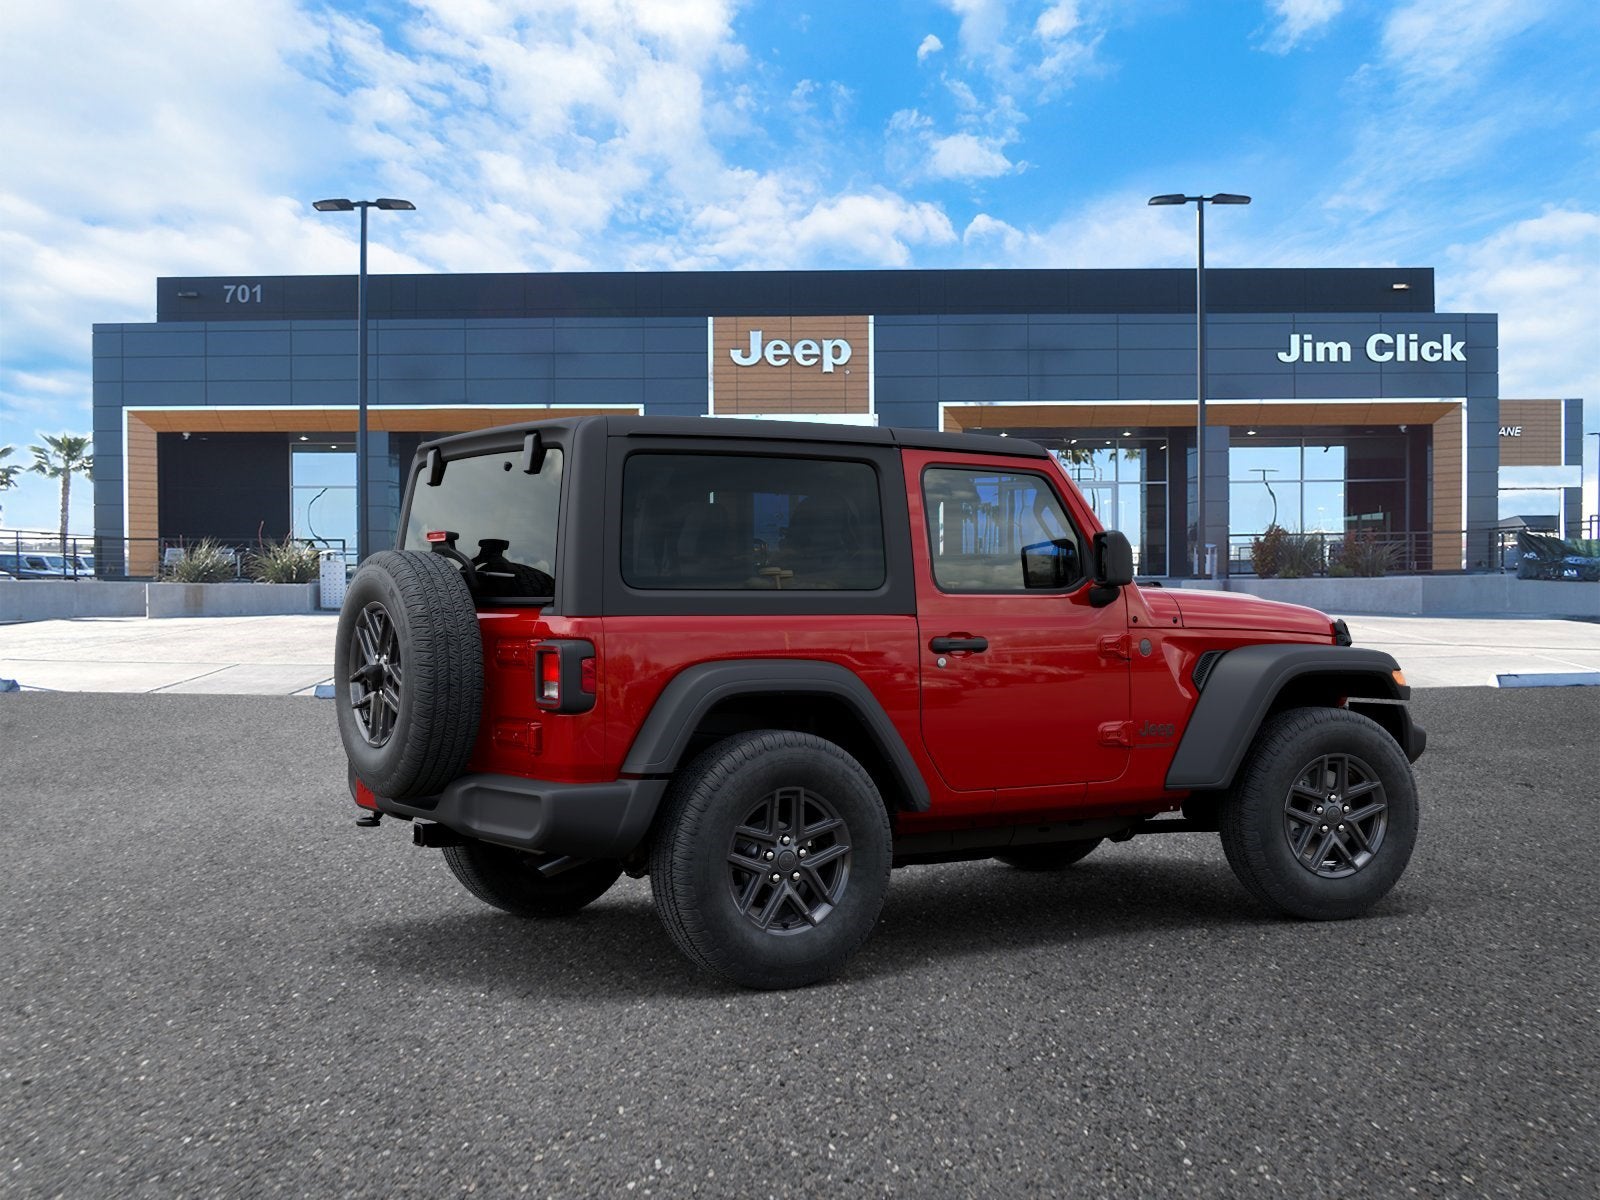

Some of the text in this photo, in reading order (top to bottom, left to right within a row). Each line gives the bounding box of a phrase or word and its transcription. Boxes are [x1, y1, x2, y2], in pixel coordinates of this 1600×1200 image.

[223, 284, 262, 304] 701
[729, 330, 852, 373] Jeep
[1277, 333, 1467, 363] Jim Click
[1498, 426, 1522, 437] ANE
[1138, 719, 1175, 739] Jeep
